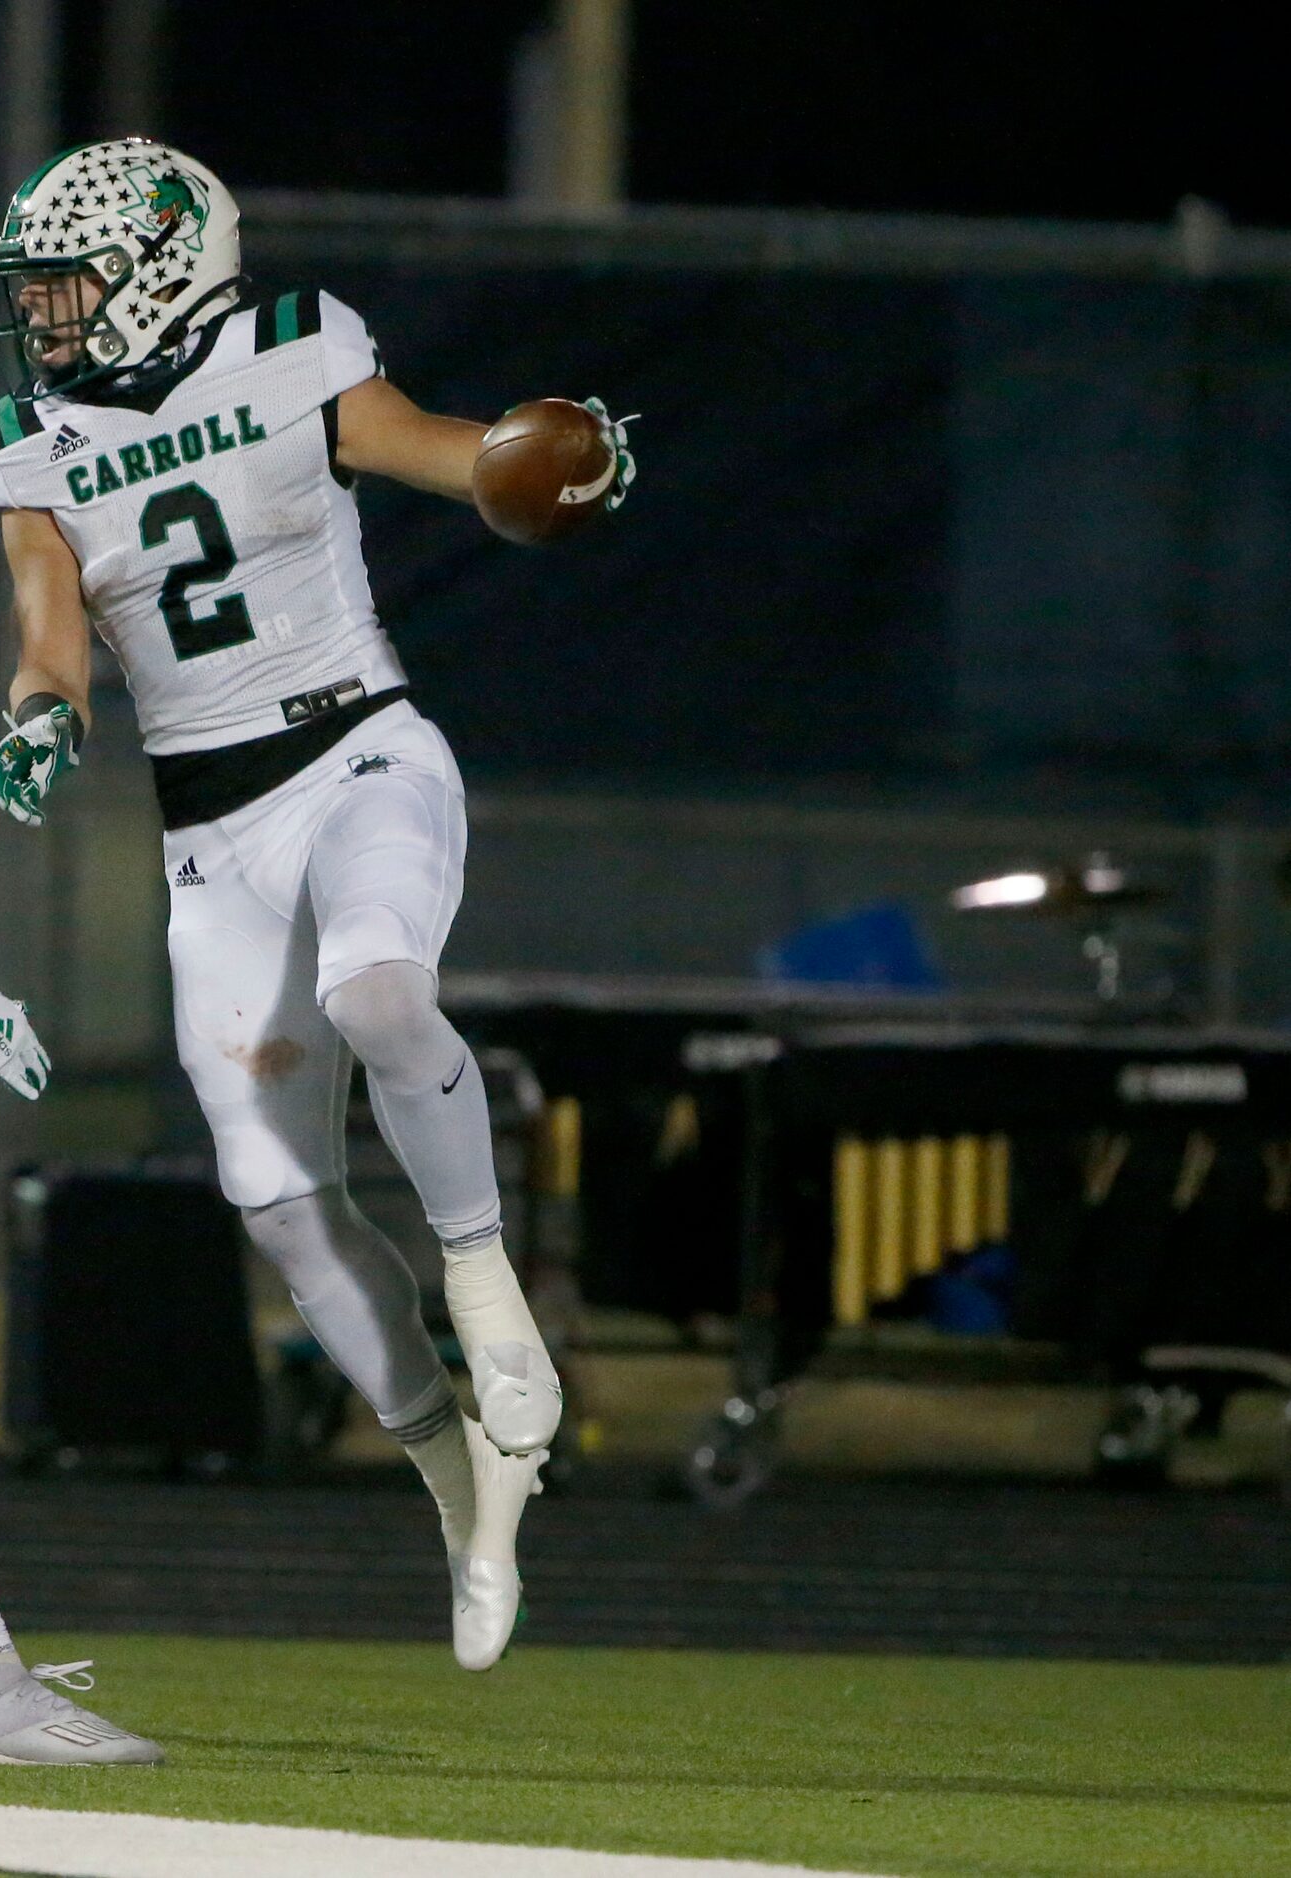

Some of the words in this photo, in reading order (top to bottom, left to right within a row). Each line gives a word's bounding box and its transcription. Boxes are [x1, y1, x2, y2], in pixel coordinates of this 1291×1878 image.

[50, 435, 90, 462] adidas
[66, 404, 266, 505] CARROLL
[139, 480, 256, 663] 2
[175, 875, 206, 888] adidas
